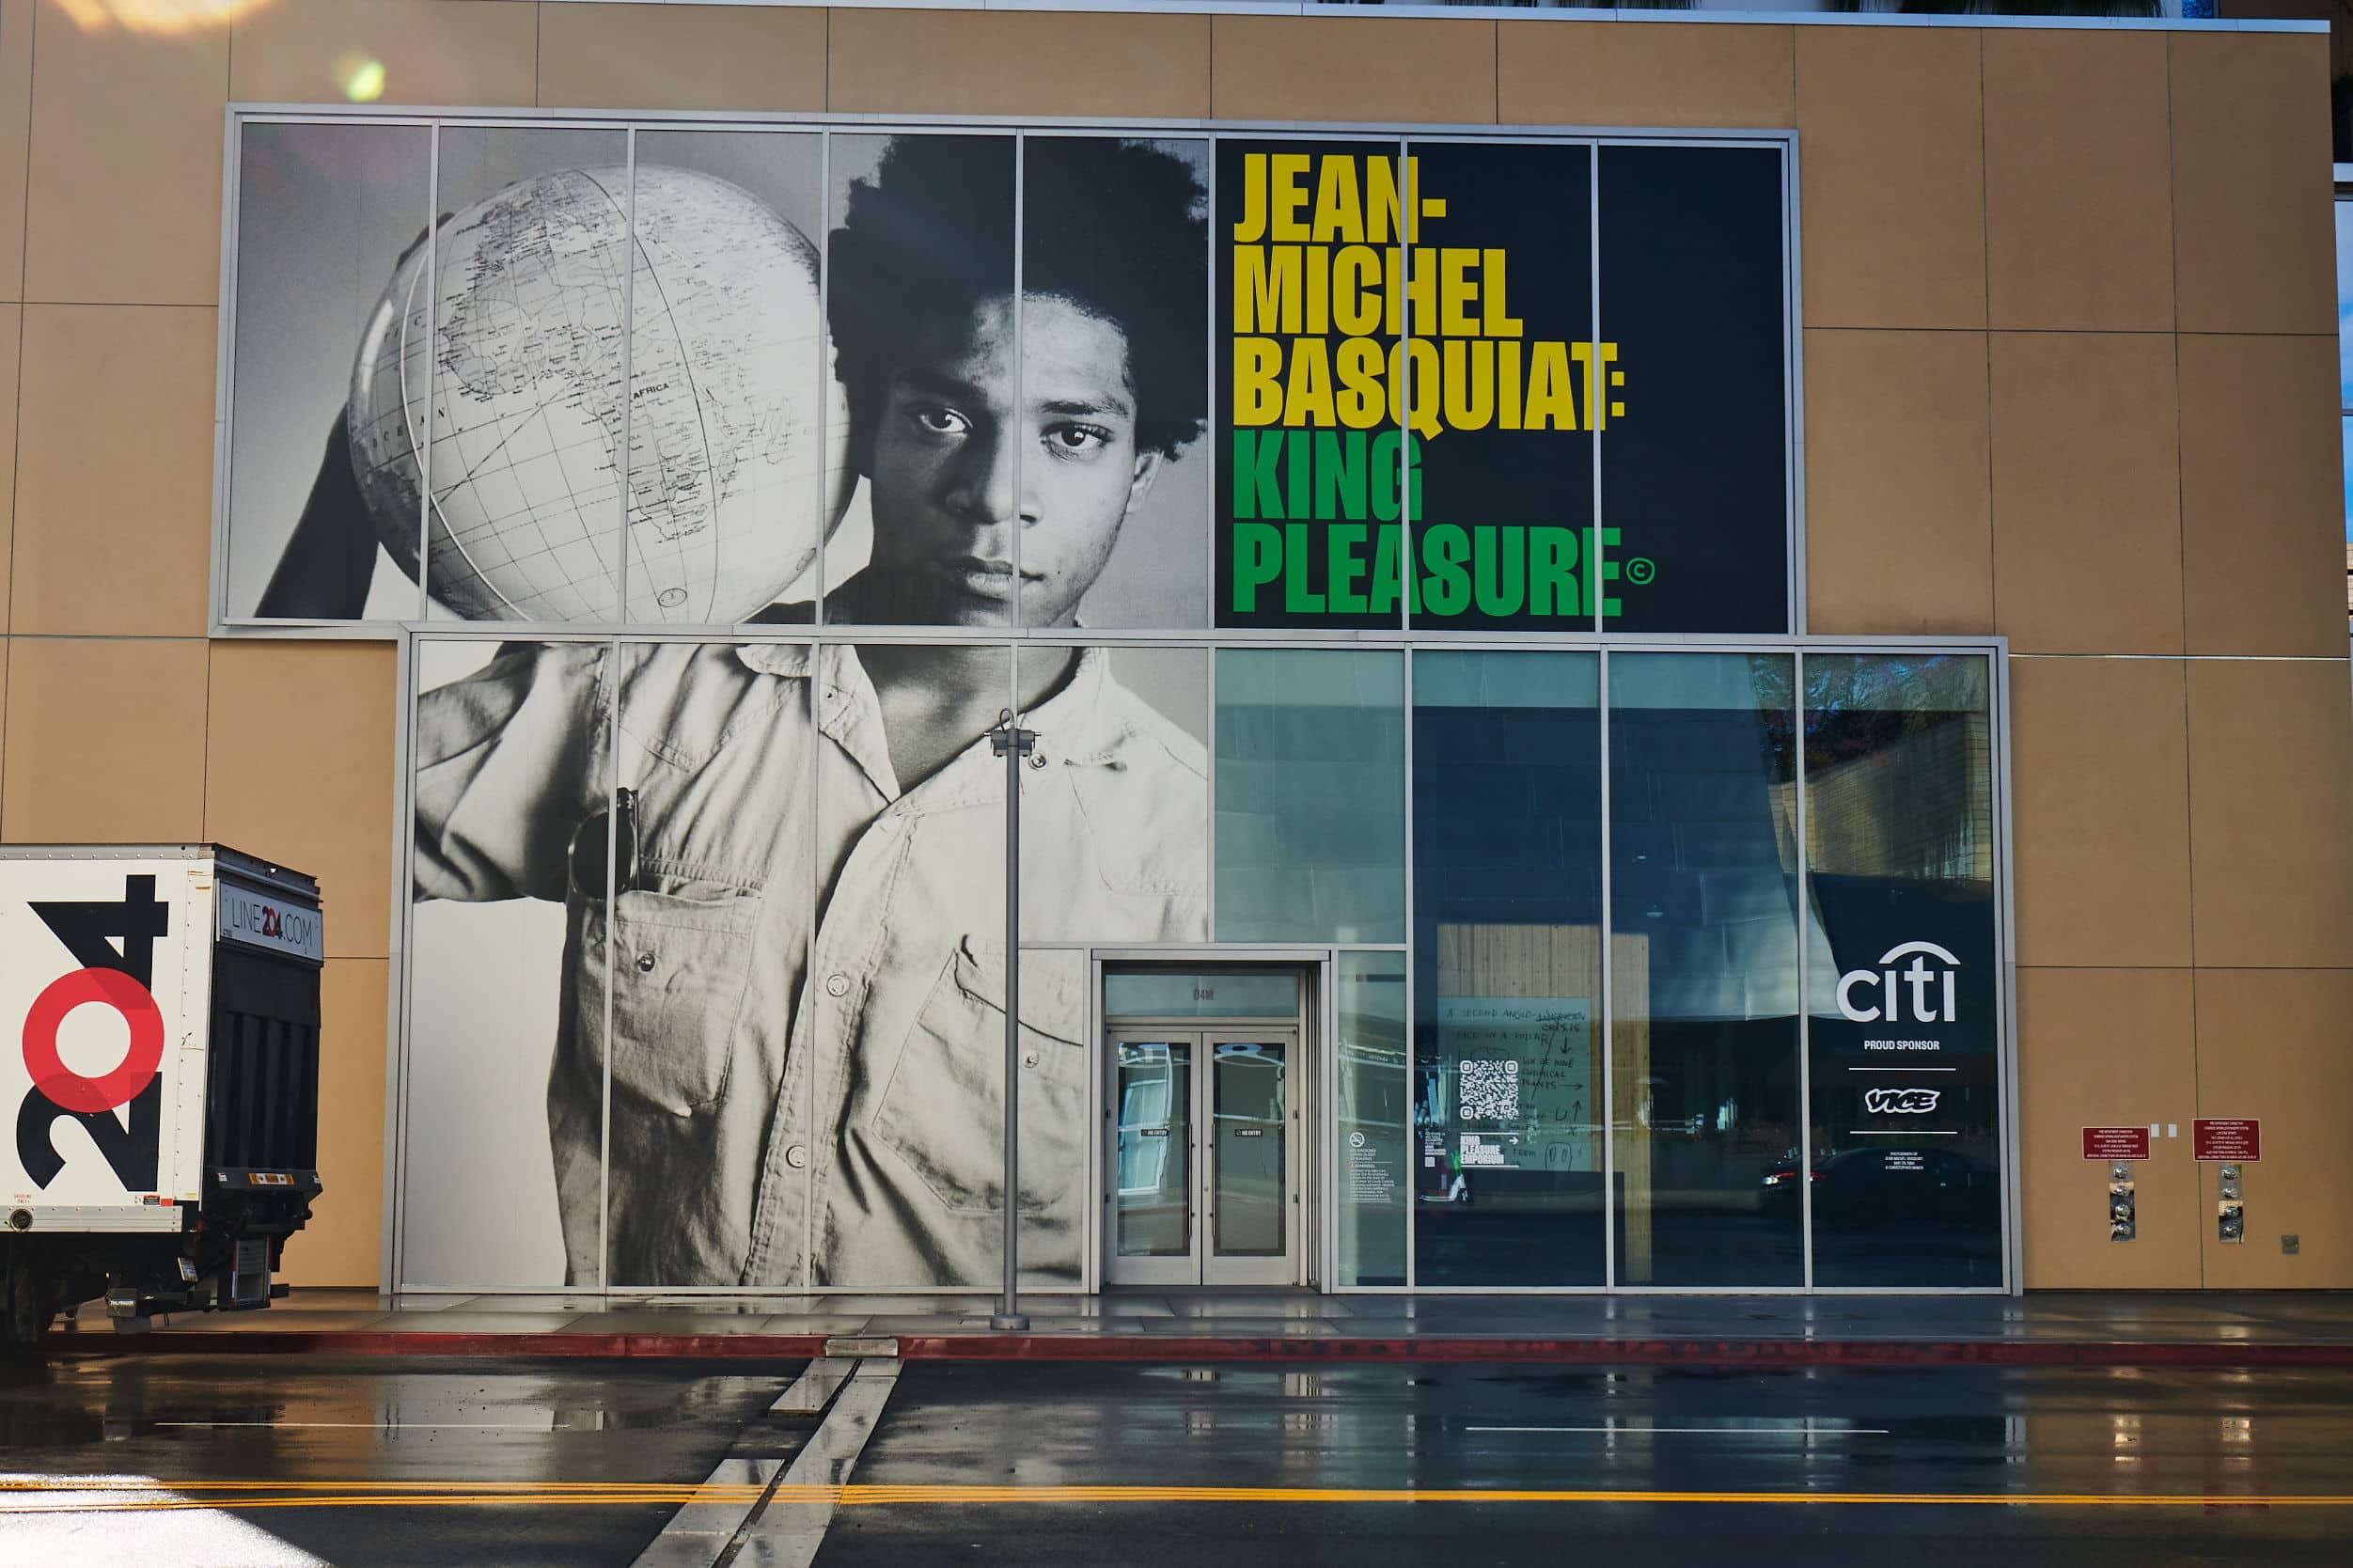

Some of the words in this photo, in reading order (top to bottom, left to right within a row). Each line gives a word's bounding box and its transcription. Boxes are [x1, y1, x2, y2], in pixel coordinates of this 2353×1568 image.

[1233, 153, 1446, 243] JEAN-
[1233, 244, 1523, 337] MICHEL
[634, 383, 669, 400] AFRICA
[1233, 337, 1624, 441] BASQUIAT:
[1233, 430, 1422, 521] KING
[232, 898, 312, 948] LINE204.COM
[1836, 955, 1956, 1023] citi
[1864, 1040, 1895, 1051] PROUD
[1896, 1040, 1940, 1051] SPONSOR
[1865, 1089, 1940, 1113] VICE
[1460, 1145, 1500, 1154] PLEASURE
[1460, 1154, 1504, 1164] EMPORIUM
